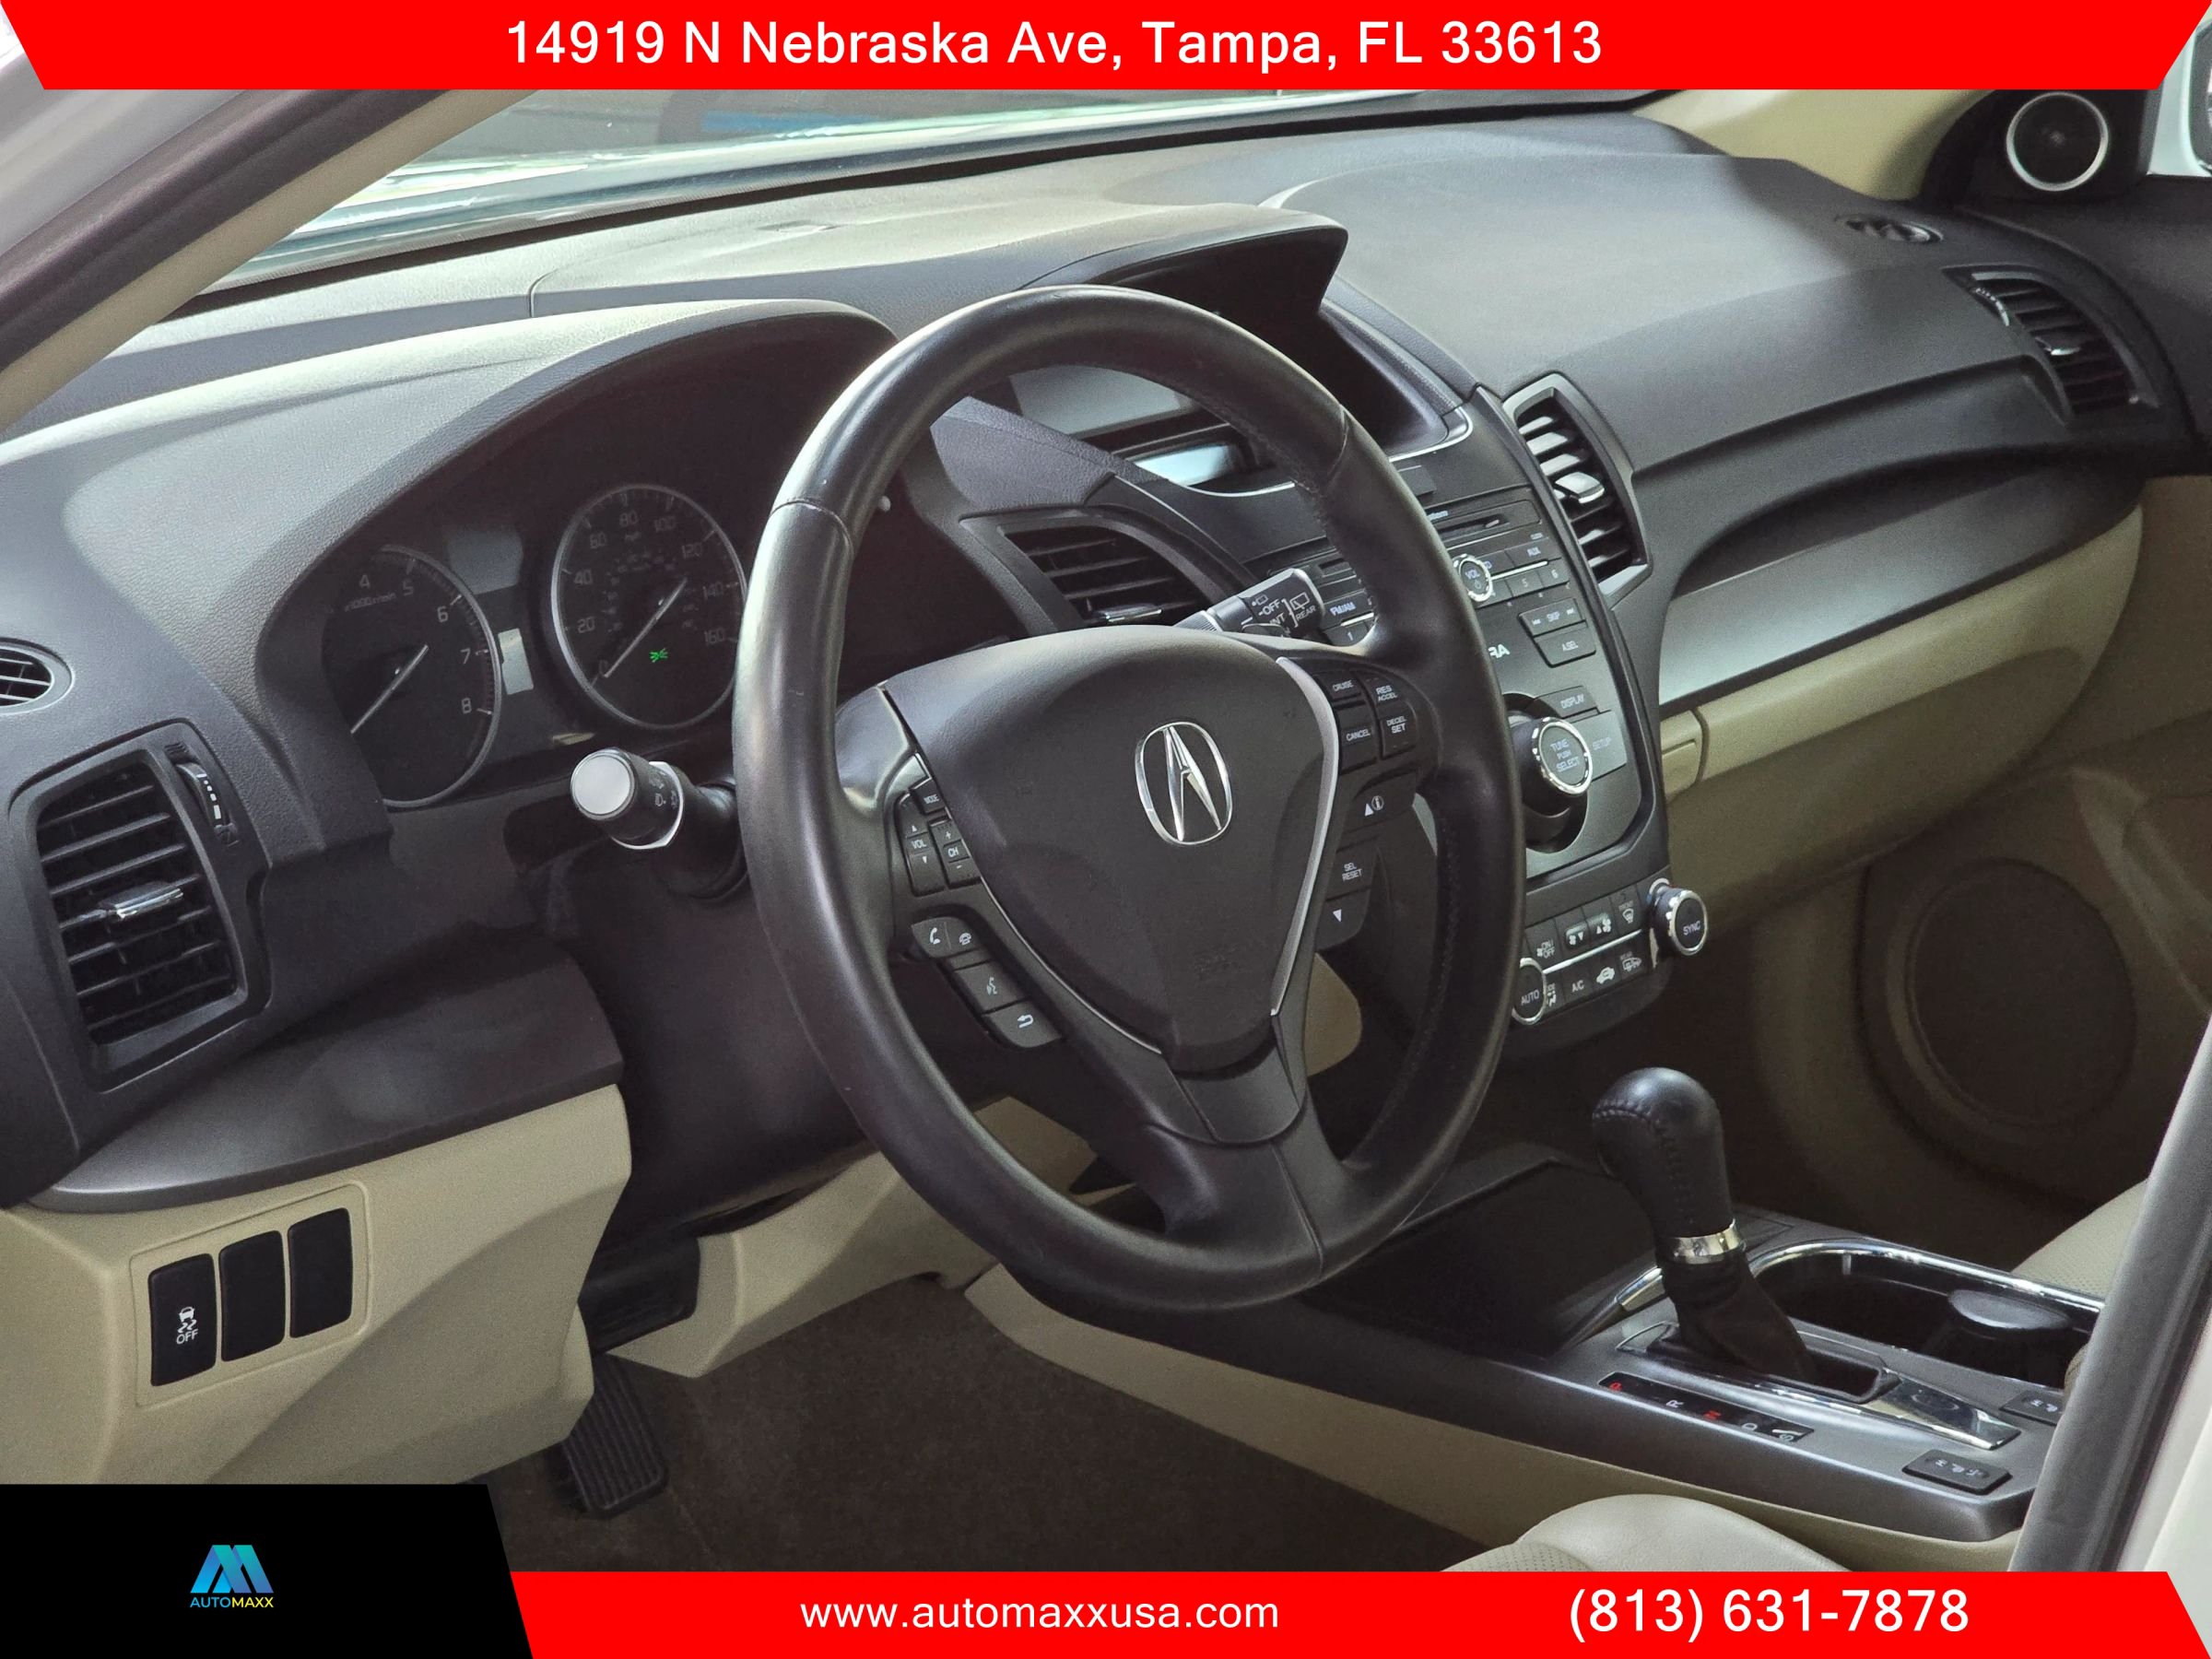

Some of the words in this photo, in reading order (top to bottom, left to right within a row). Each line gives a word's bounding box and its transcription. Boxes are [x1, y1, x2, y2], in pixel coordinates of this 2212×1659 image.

[619, 510, 638, 527] 80
[653, 515, 676, 532] 100
[681, 542, 703, 559] 120
[359, 573, 371, 589] 4
[573, 569, 593, 585] 40
[1551, 569, 1559, 579] 6
[402, 577, 415, 597] 5
[702, 582, 724, 599] 140
[437, 605, 449, 624] 6
[1262, 598, 1281, 616] OFF
[1295, 604, 1317, 622] REAR
[577, 616, 596, 633] 20
[703, 628, 726, 644] 160
[461, 647, 472, 665] 7
[1332, 679, 1355, 692] CRUISE
[1375, 684, 1393, 695] RES
[1377, 691, 1398, 702] ACCEL
[1559, 693, 1584, 709] DISPLAY
[461, 697, 473, 714] 8
[1386, 715, 1407, 726] DECEL
[1346, 728, 1371, 742] CANCEL
[1391, 723, 1406, 735] SET
[1550, 738, 1570, 752] TUNE
[1592, 736, 1613, 751] SETUP
[1556, 756, 1581, 772] SELECT
[910, 839, 927, 850] VOL
[947, 846, 960, 858] CH
[1341, 868, 1362, 881] RESET
[1343, 862, 1358, 872] SEL
[1682, 920, 1702, 936] SYNC
[1542, 947, 1556, 959] OFF
[1571, 980, 1585, 993] A/C
[1521, 989, 1540, 1006] AUTO
[176, 1327, 199, 1345] OFF
[1665, 1398, 1685, 1409] R
[1741, 1421, 1759, 1431] D
[1779, 1432, 1794, 1442] S
